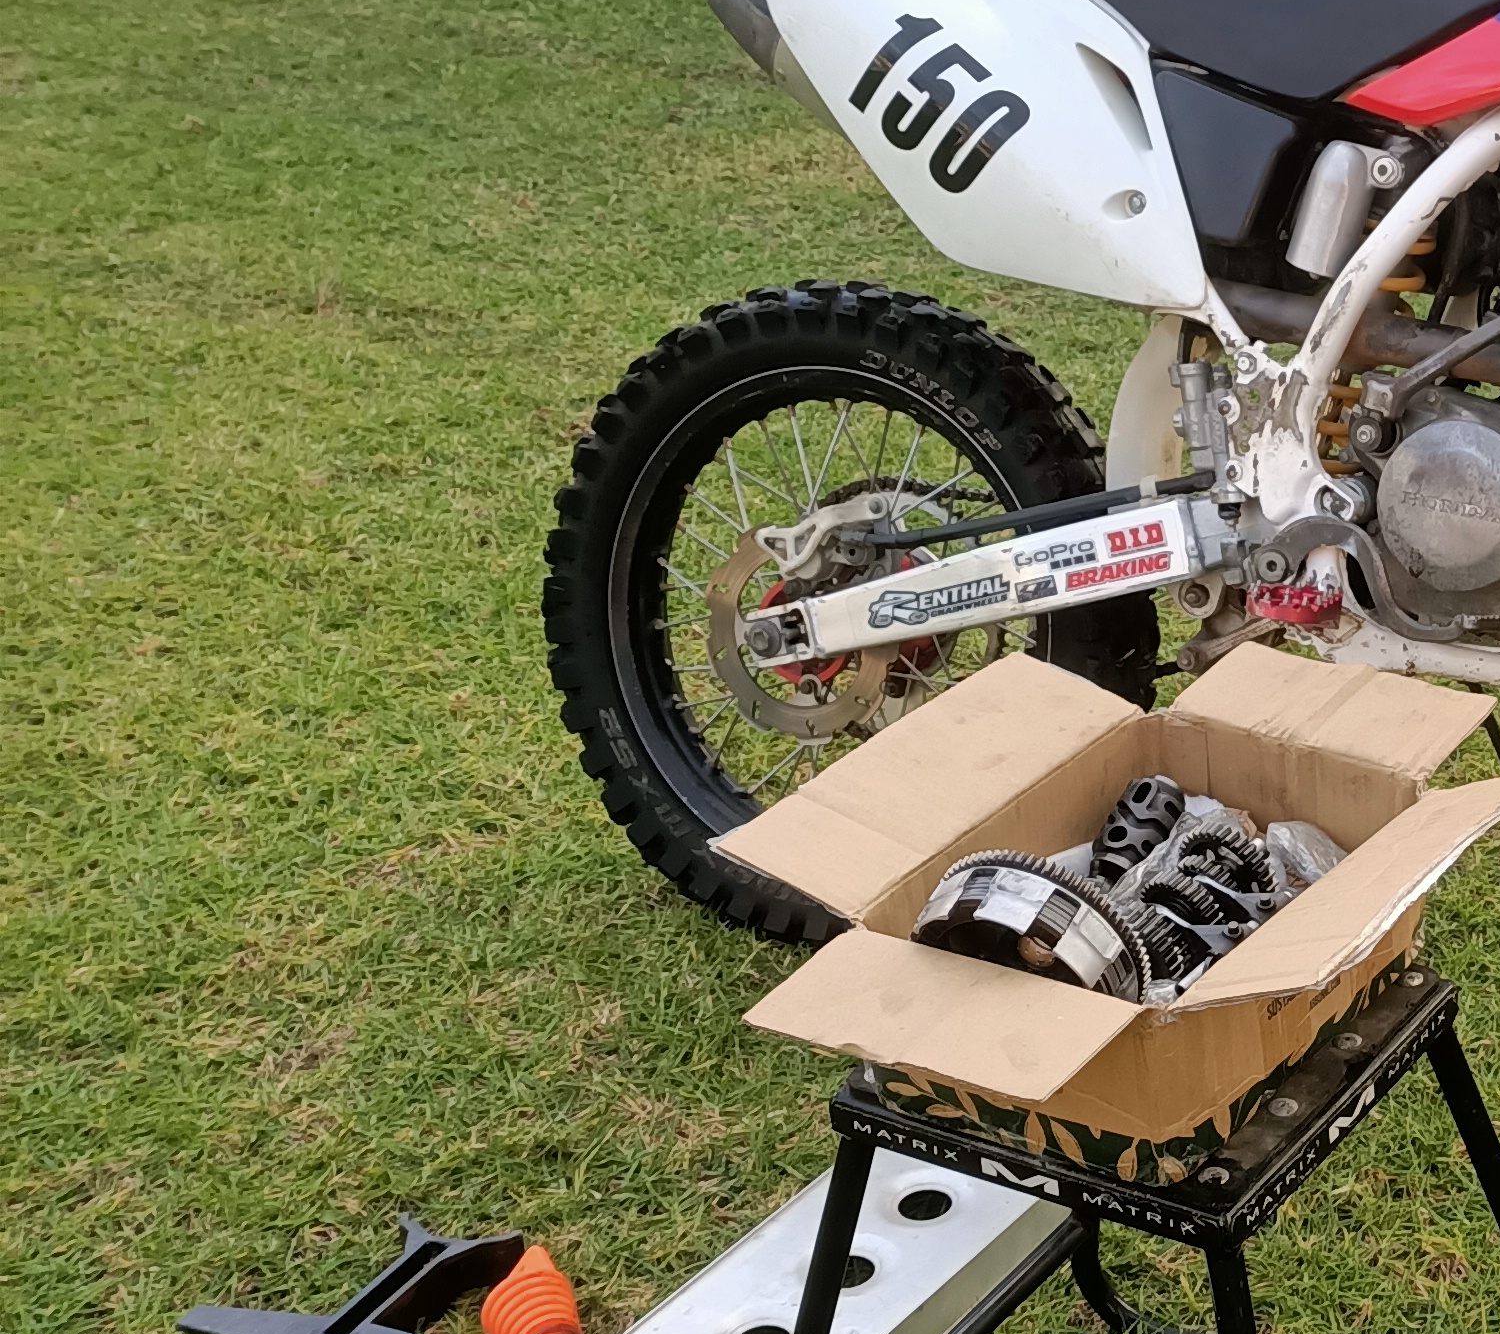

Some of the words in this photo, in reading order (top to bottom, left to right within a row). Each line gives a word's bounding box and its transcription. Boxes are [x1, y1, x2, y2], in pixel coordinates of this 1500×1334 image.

[849, 13, 1031, 194] 150
[1014, 540, 1096, 568] GoPro
[1066, 553, 1171, 590] BRAKING
[868, 573, 1011, 628] RENTHAL
[853, 1120, 959, 1163] MATRIX
[1083, 1192, 1197, 1236] MATRIX
[1246, 1147, 1317, 1226] MATRIX
